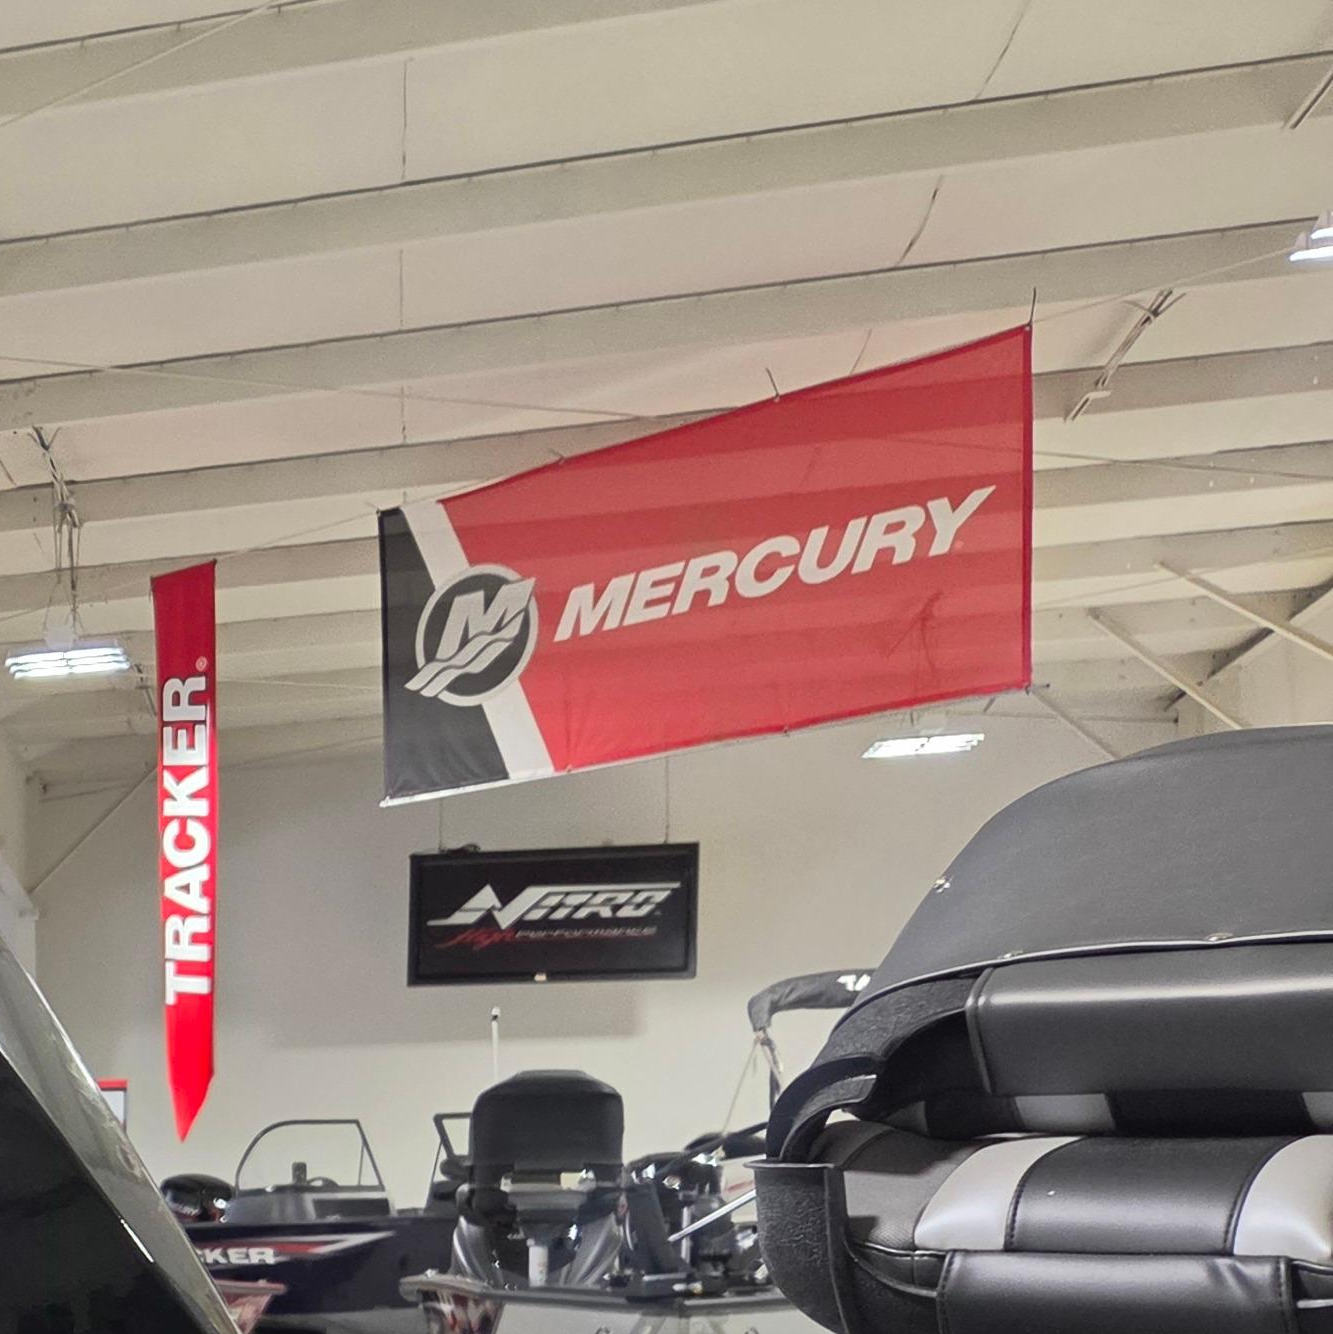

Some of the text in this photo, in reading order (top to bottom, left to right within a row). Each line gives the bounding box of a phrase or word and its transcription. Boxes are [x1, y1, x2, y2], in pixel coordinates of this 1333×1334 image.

[552, 485, 997, 642] MERCURY
[162, 675, 212, 1006] TRACKER
[426, 882, 681, 930] NITRO
